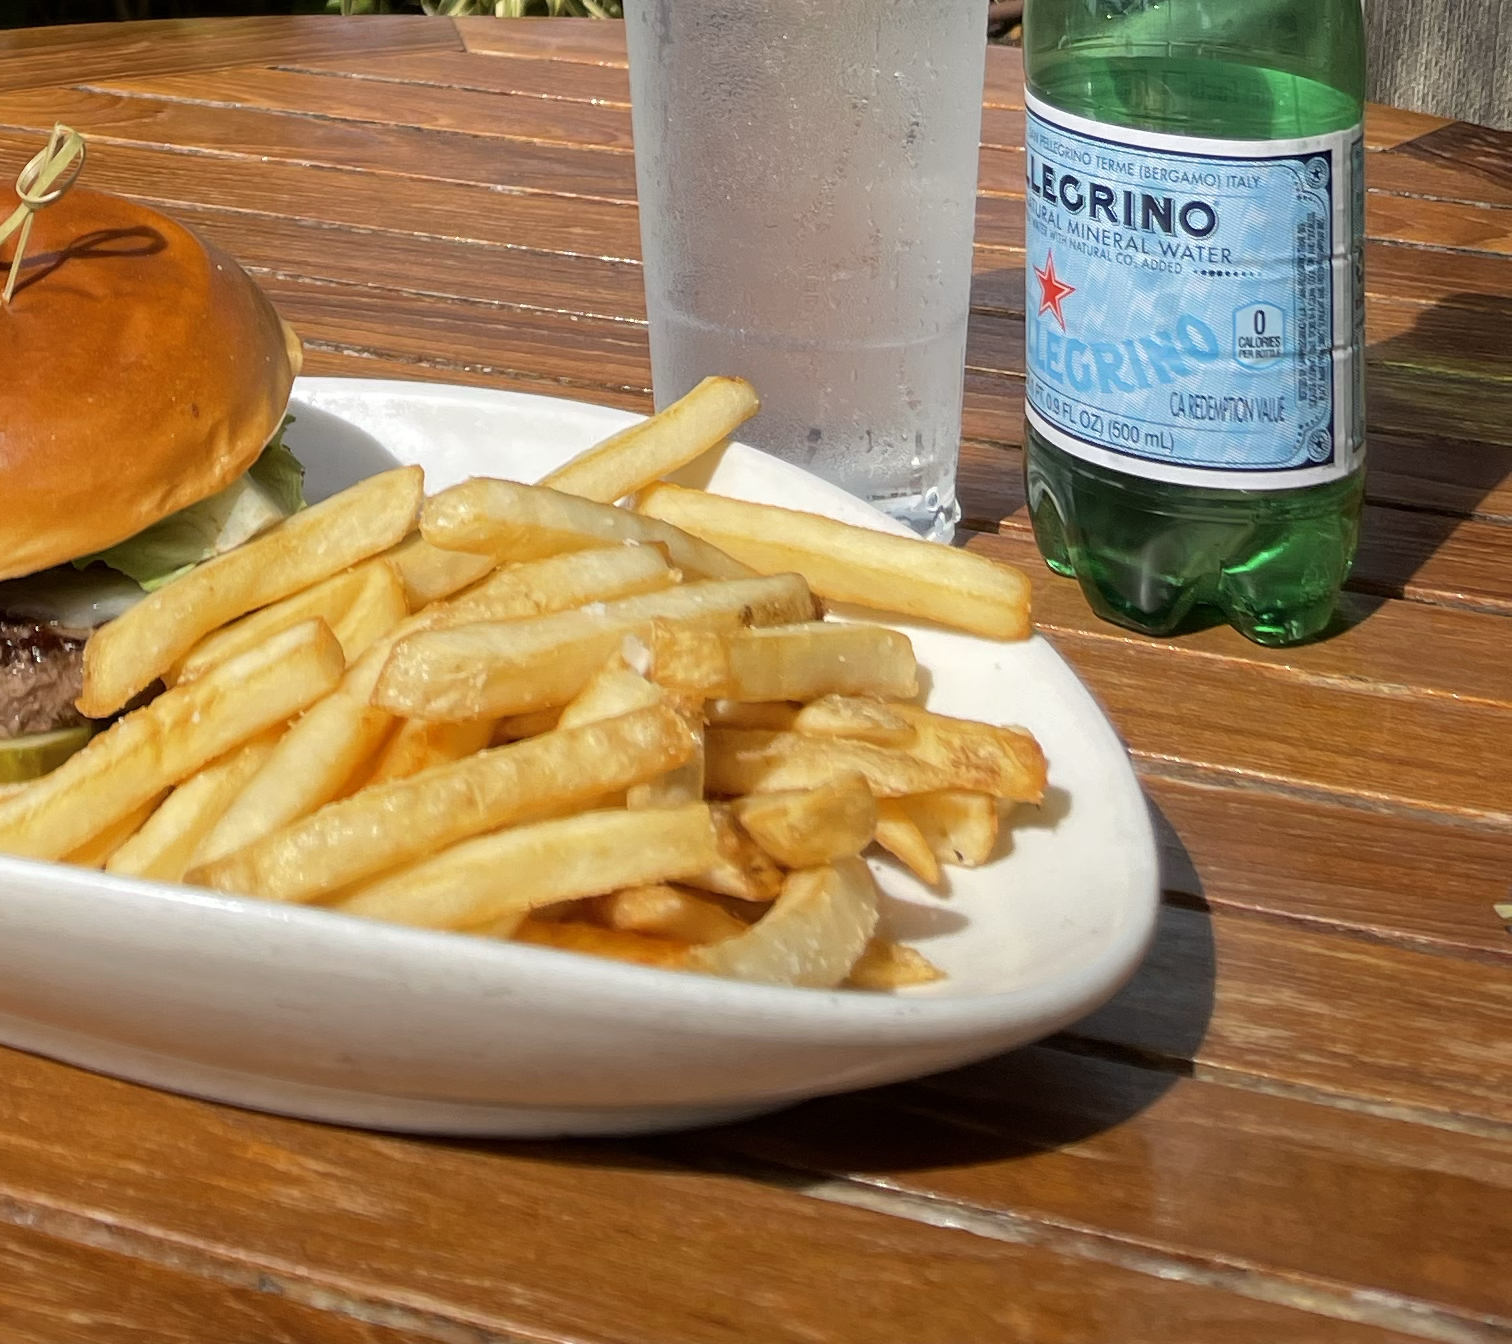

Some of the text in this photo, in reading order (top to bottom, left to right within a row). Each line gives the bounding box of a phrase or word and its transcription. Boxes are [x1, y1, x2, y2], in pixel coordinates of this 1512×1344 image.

[1095, 155, 1135, 177] TERME
[1139, 165, 1222, 188] (BERGAMO)
[1226, 175, 1261, 189] ITALY
[1026, 154, 1219, 240] LEGRINO
[1067, 220, 1151, 255] MINERAL
[1158, 239, 1232, 264] WATER
[1069, 237, 1112, 262] NATURAL
[1141, 258, 1183, 274] ADDED
[1253, 309, 1266, 335] 0
[1238, 336, 1281, 349] CALORIES
[1170, 392, 1285, 424] CA REDEMPTION VALUE
[1062, 402, 1076, 425] FL
[1079, 411, 1104, 436] OZ)
[1108, 419, 1140, 443] (500
[1145, 431, 1174, 452] mL)
